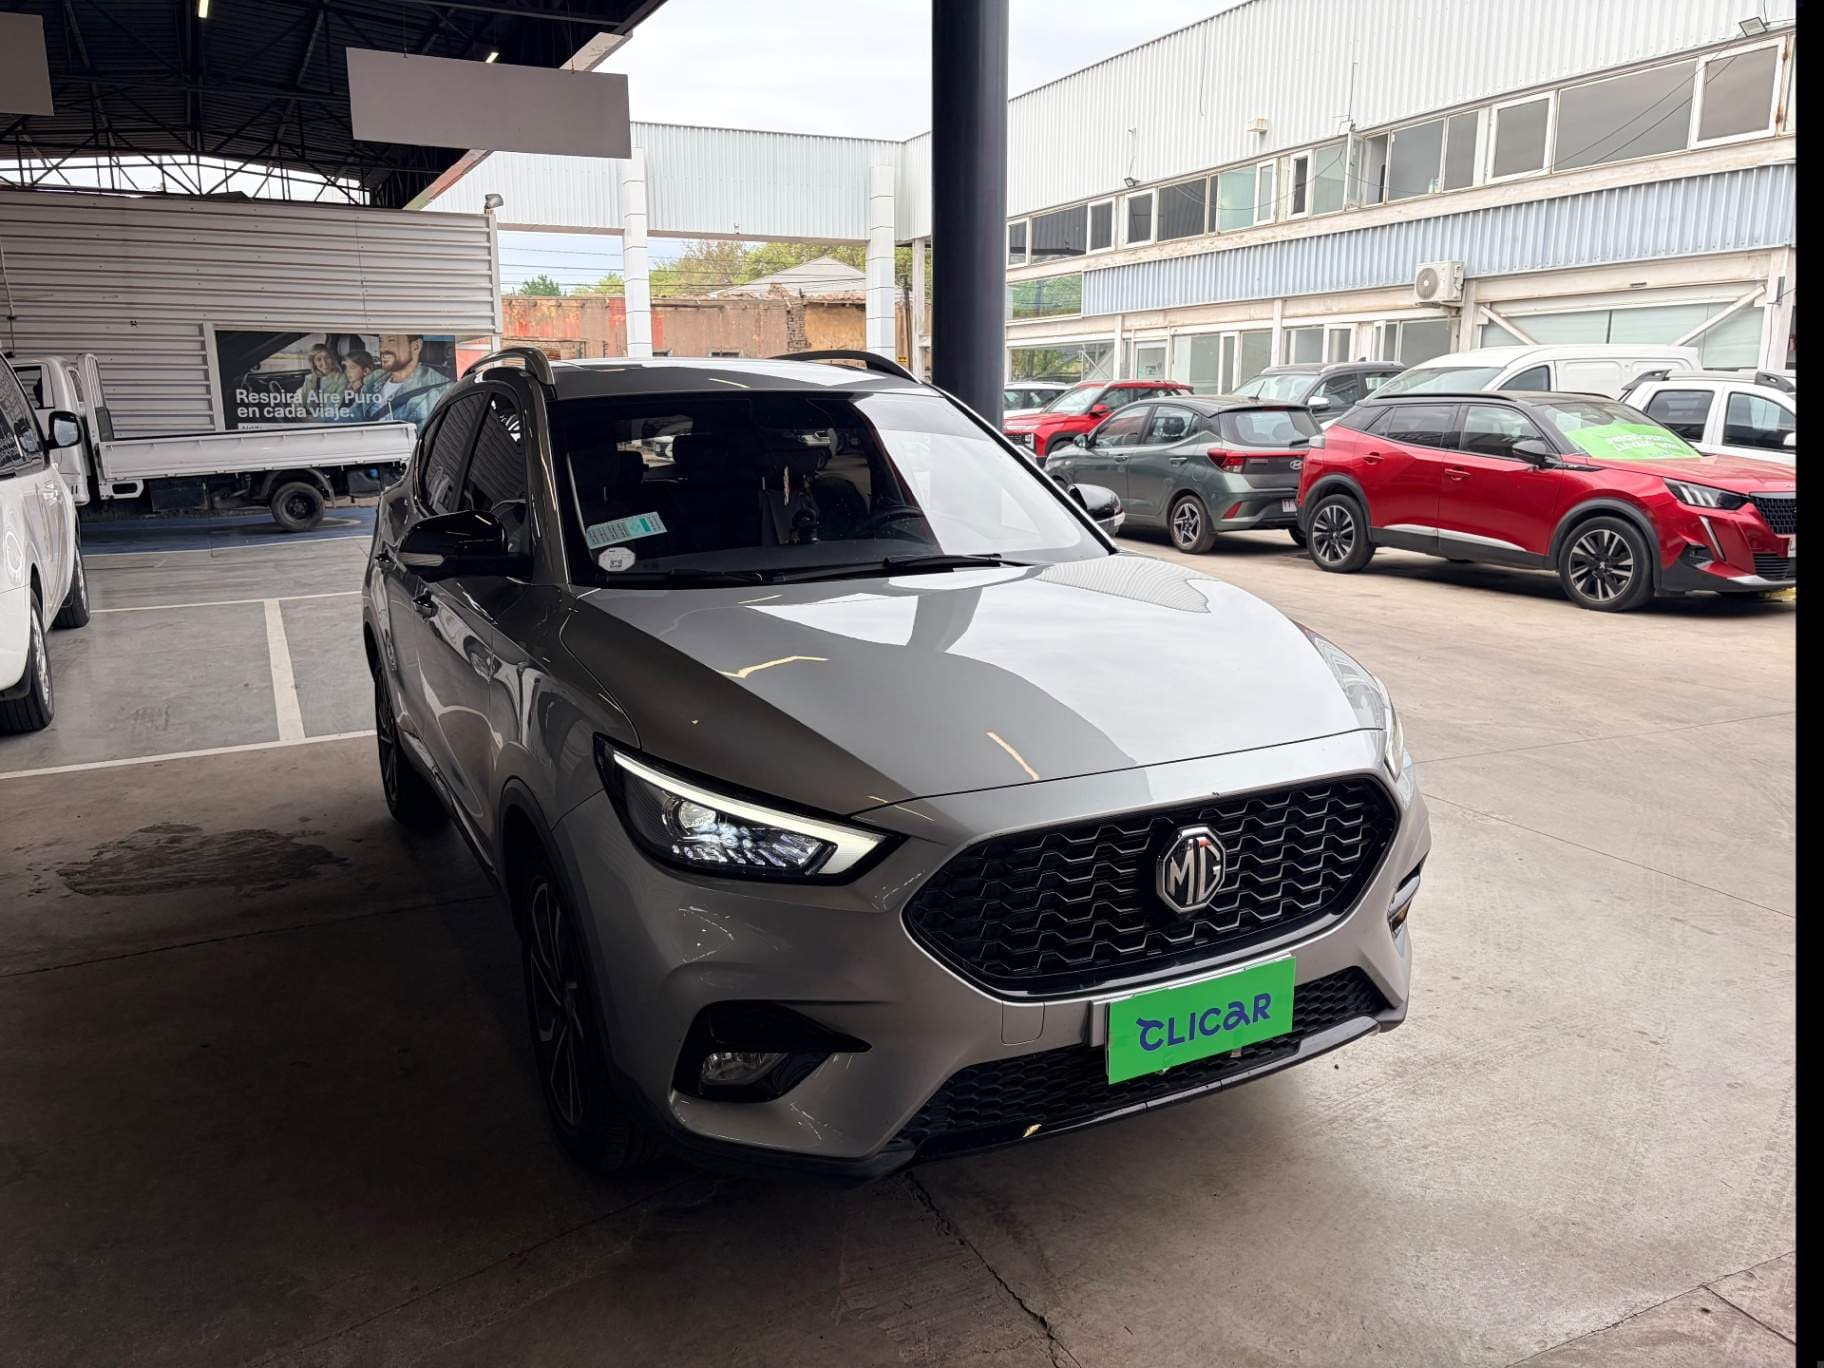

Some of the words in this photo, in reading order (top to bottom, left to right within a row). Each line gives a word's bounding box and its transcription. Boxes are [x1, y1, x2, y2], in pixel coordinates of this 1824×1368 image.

[235, 389, 303, 407] Respira
[307, 390, 340, 404] Aire
[344, 390, 382, 404] Puro
[237, 406, 260, 418] en
[263, 404, 307, 418] cada
[309, 404, 355, 421] viaje.
[1167, 836, 1221, 905] MG
